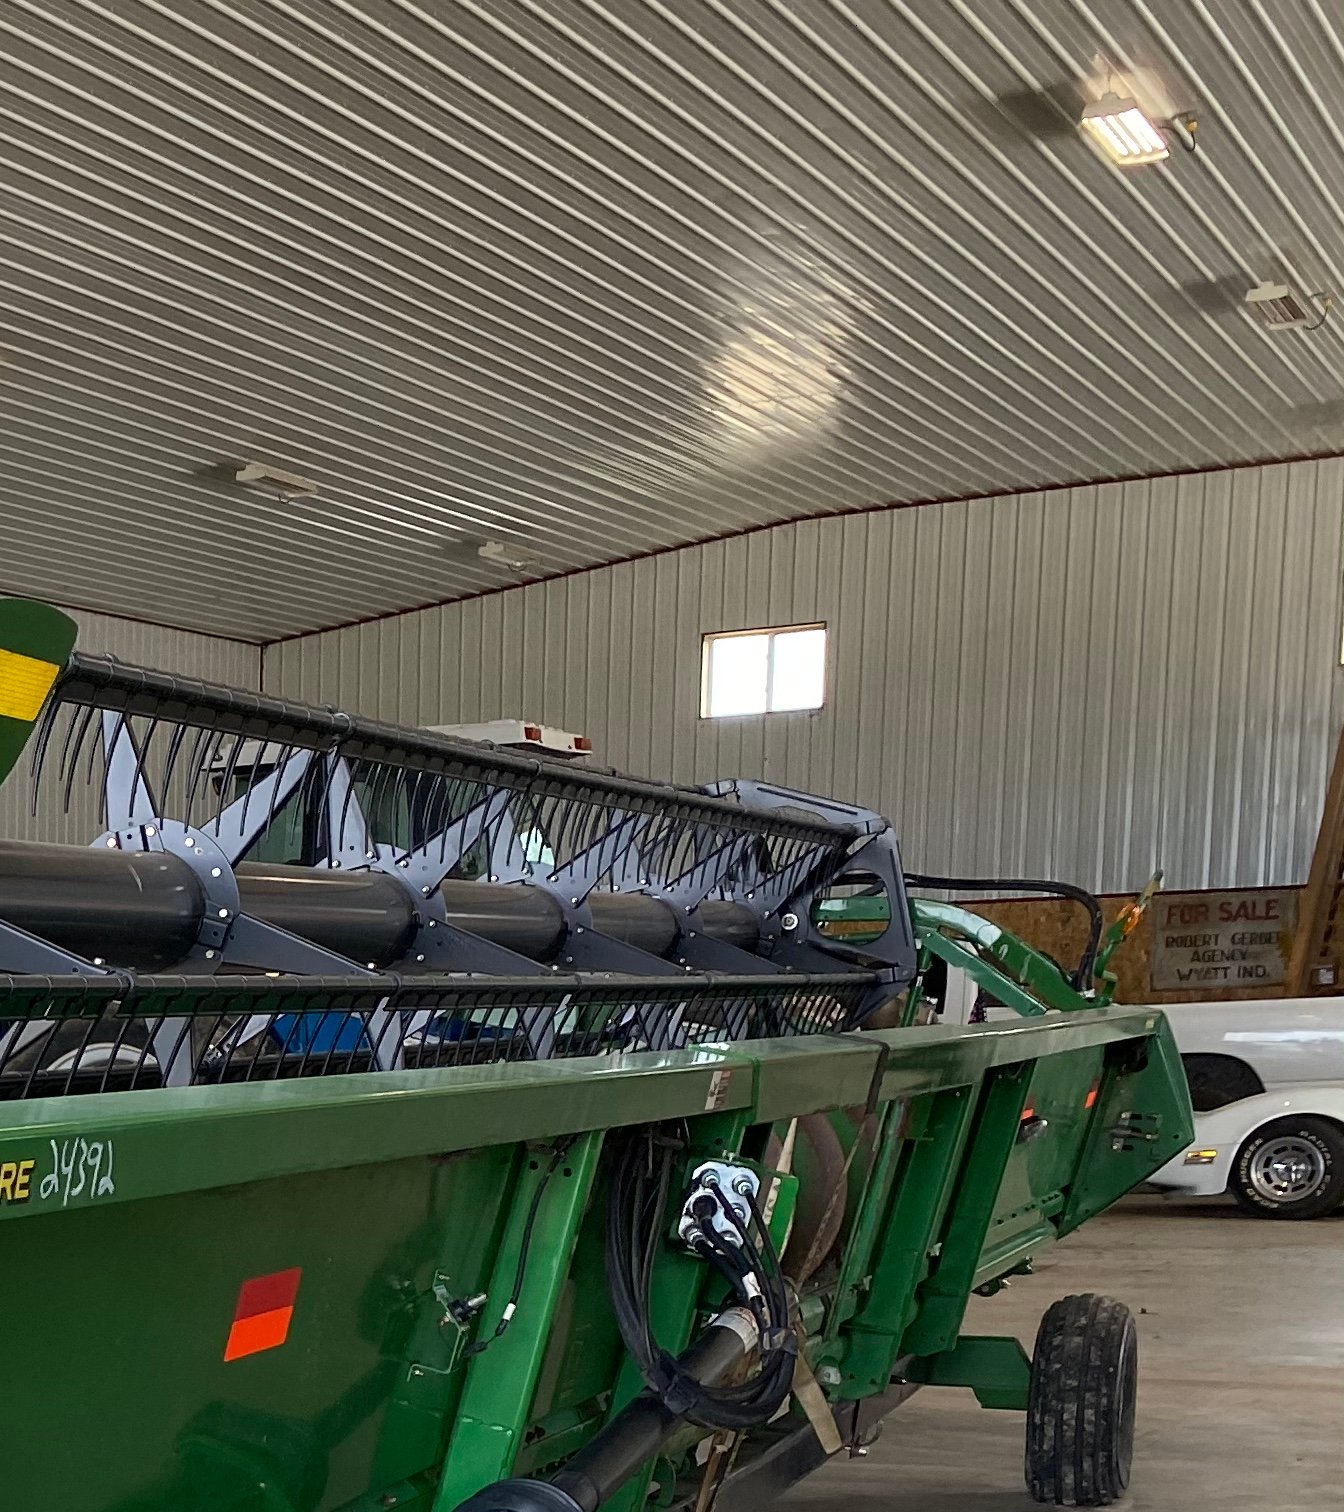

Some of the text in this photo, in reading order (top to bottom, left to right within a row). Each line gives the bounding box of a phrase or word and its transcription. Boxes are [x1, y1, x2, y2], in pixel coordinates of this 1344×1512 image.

[1166, 899, 1280, 926] FOR SALE
[1230, 931, 1281, 945] GERBE
[1191, 949, 1247, 963] AGENCY
[1176, 966, 1231, 982] WYATT
[40, 1136, 115, 1206] 24392
